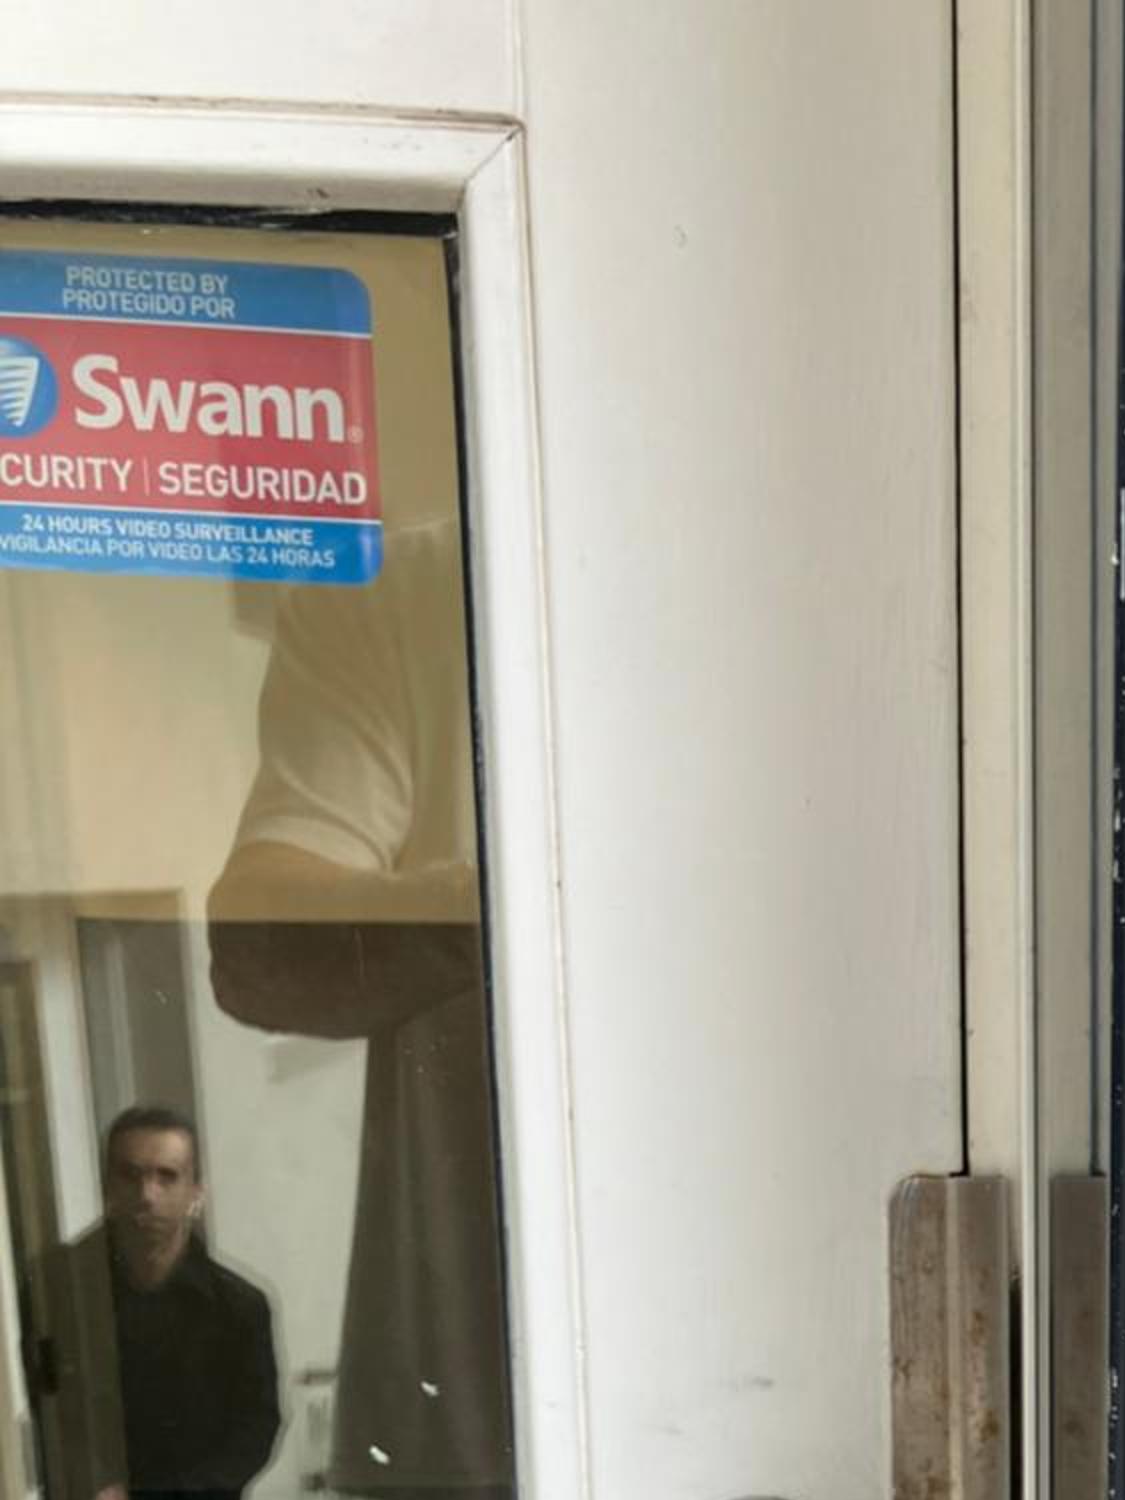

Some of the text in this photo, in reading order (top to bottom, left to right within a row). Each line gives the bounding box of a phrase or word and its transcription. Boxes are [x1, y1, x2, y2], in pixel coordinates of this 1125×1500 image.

[65, 265, 229, 295] PROTECTED BY
[62, 287, 236, 319] PROTEGIDO POR
[0, 452, 368, 505] CURITY SEGURIDAD
[22, 513, 314, 546] 24 HOURS VIDEO SURVEILLANCE
[0, 532, 336, 568] VIGILANCIA POR VIDEO LAS 24 HORAS
